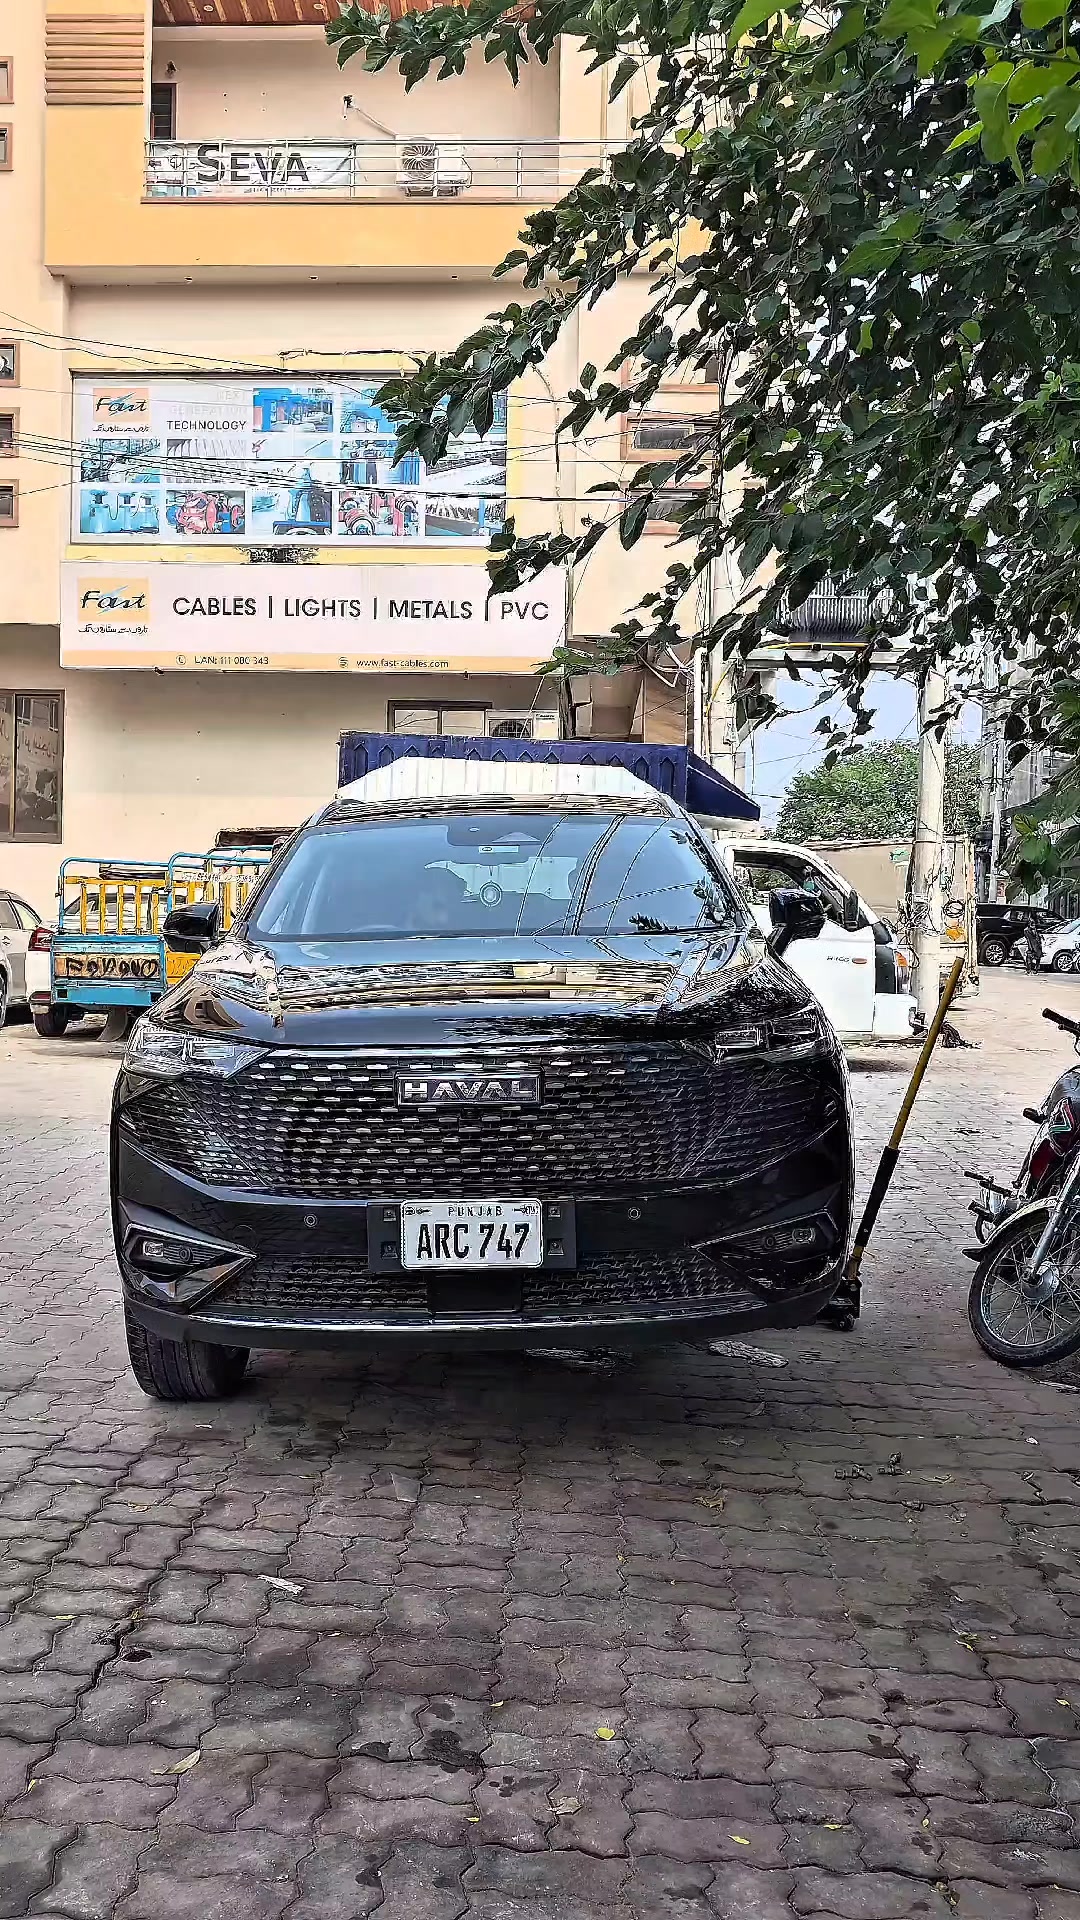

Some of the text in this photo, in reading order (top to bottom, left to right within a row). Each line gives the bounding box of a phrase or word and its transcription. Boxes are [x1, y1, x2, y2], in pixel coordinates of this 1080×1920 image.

[197, 143, 309, 182] SEVA
[95, 396, 148, 413] Fast
[166, 420, 247, 431] TECHNOLOGY
[80, 590, 147, 609] Fast
[173, 597, 549, 621] CABLES LIGHTS METALS PVC
[356, 659, 449, 669] www.fast-cables.com
[404, 1080, 533, 1099] HAVAL
[448, 1205, 504, 1217] PUNJAB
[417, 1222, 531, 1259] ARC 747
